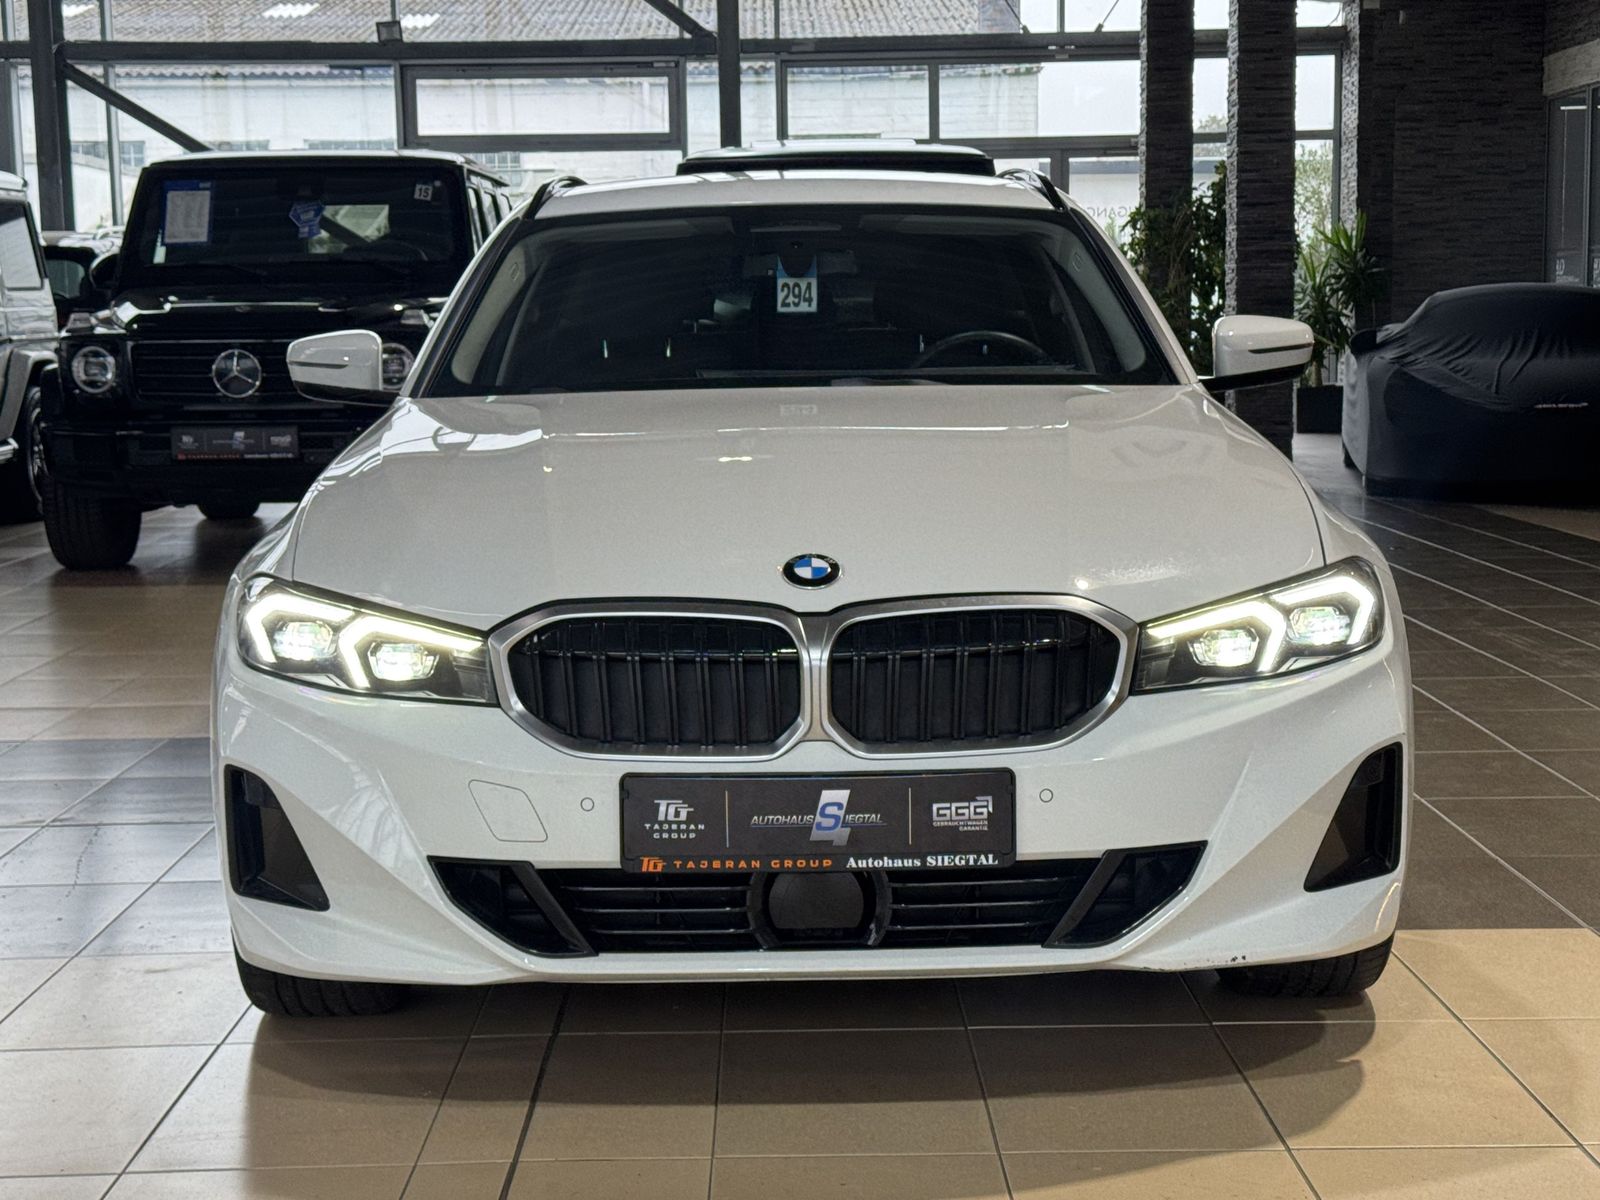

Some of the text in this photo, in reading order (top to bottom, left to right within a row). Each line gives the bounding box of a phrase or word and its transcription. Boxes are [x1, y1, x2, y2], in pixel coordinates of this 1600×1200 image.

[418, 187, 430, 198] 15
[780, 281, 814, 308] 294
[654, 799, 694, 821] TG
[932, 800, 988, 821] GGG
[751, 814, 814, 825] AUTOHAUS
[640, 856, 833, 872] TG TAJERAN GROUP
[845, 853, 999, 868] Autohaus SIEGTAL
